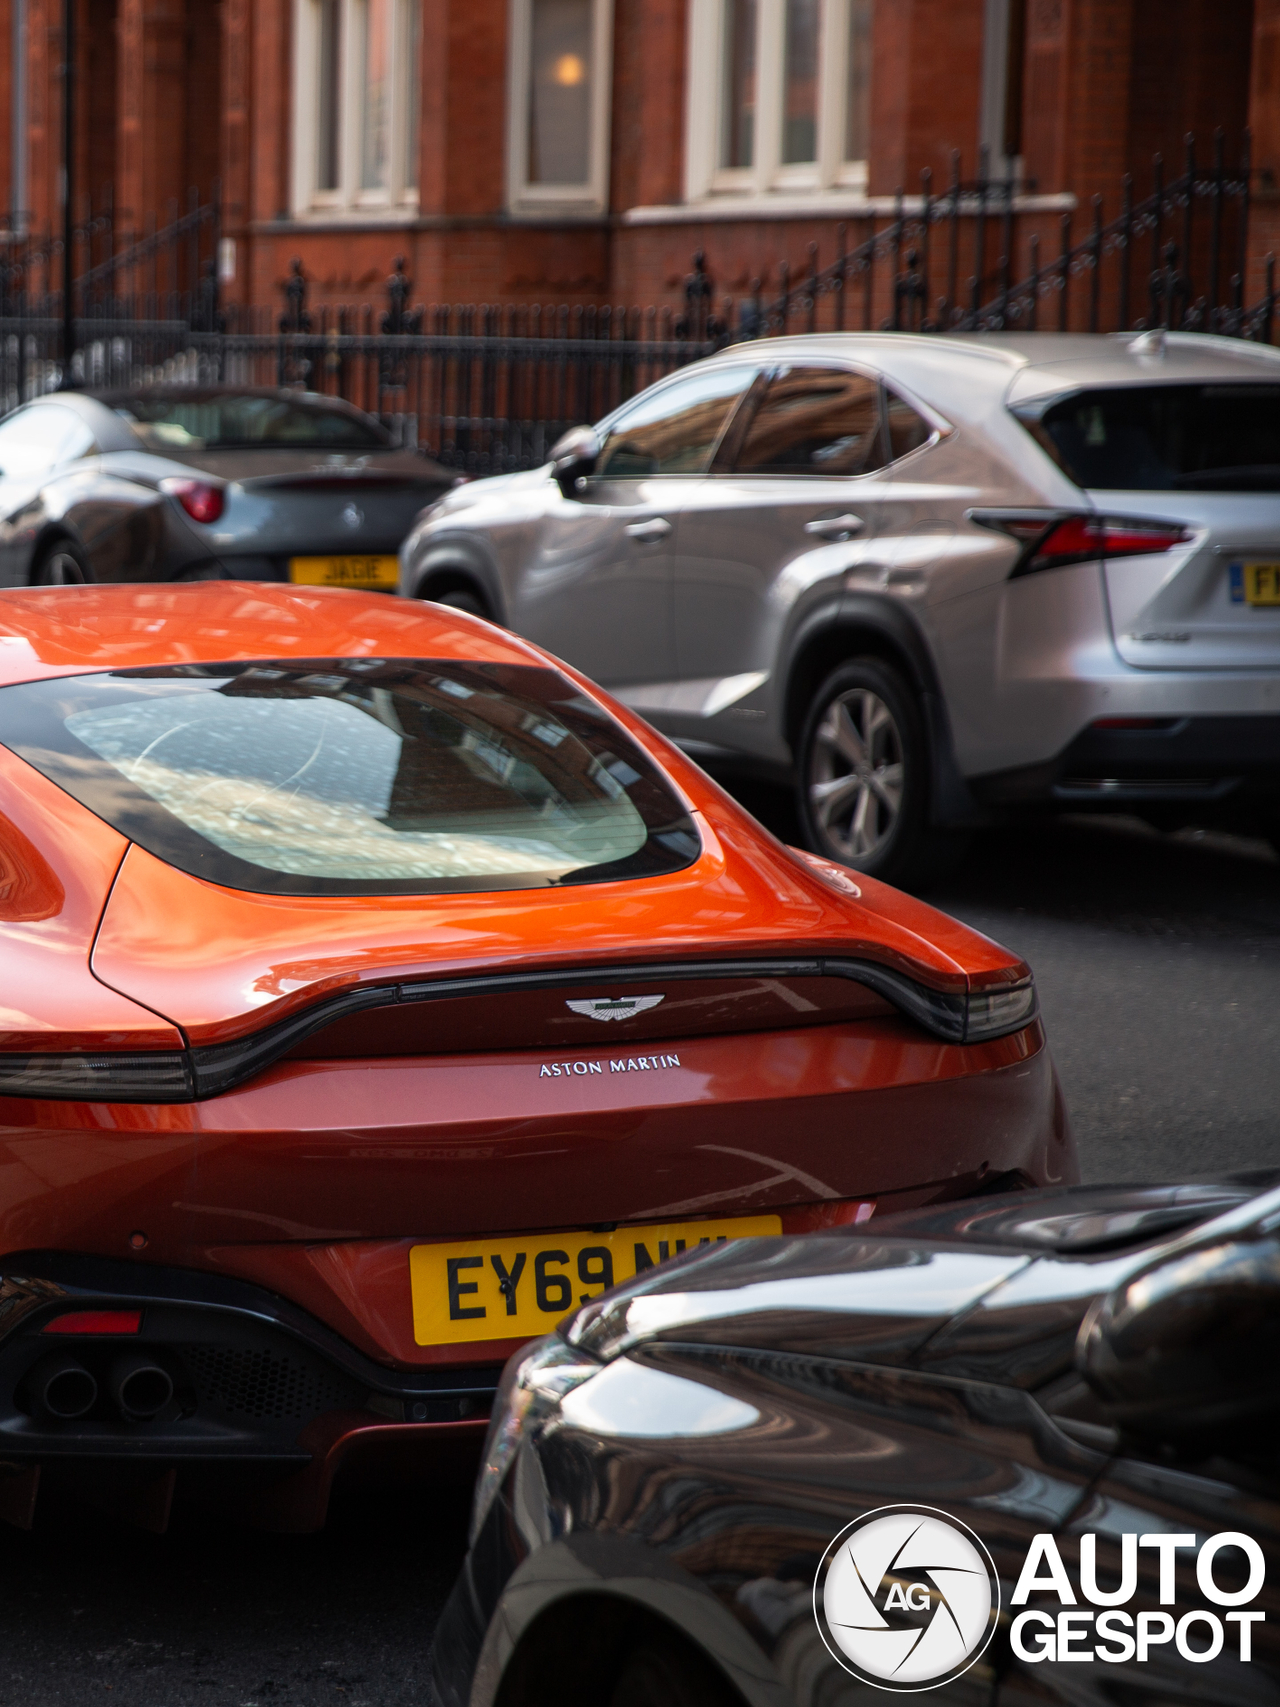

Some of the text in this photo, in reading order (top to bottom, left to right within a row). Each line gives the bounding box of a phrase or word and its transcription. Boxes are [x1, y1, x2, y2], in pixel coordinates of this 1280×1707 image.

[1254, 565, 1280, 596] F
[539, 1054, 681, 1078] ASTON MARTIN
[447, 1246, 615, 1320] EY69
